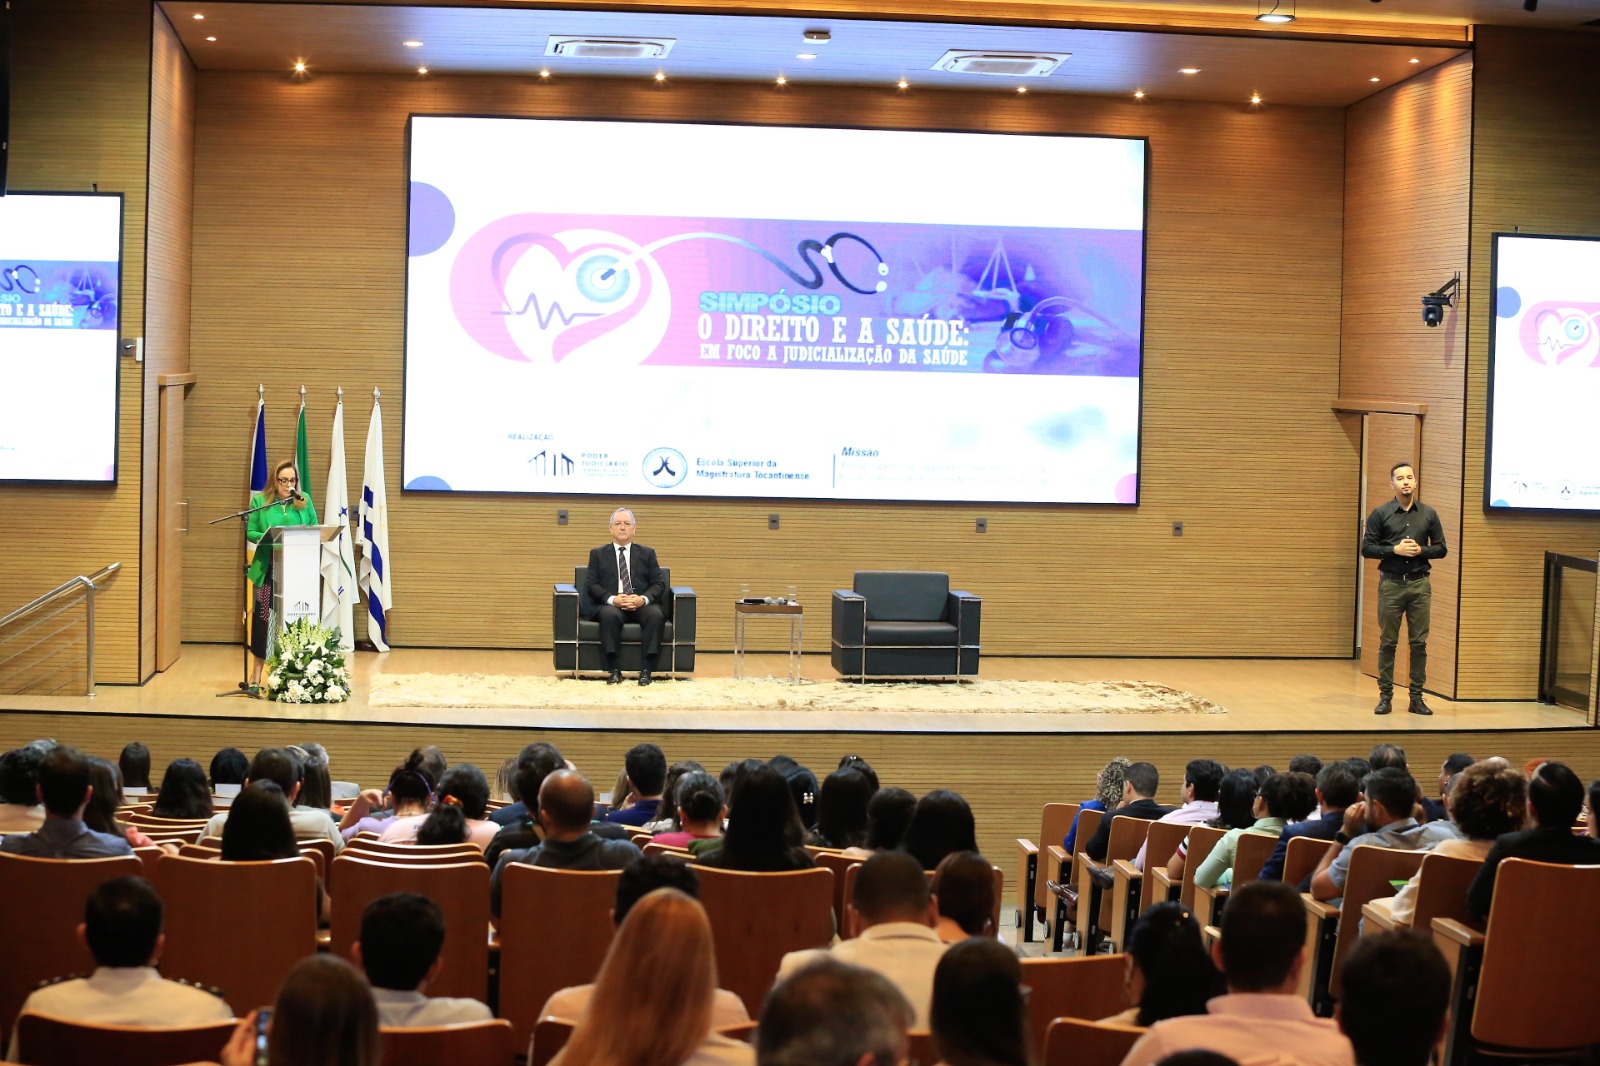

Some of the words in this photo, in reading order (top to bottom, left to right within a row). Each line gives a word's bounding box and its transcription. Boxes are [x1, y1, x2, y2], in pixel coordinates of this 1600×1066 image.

[16, 303, 24, 317] E
[27, 303, 35, 317] A
[698, 288, 842, 315] SIMPÓSIO
[697, 313, 713, 341] O
[725, 314, 820, 343] DIREITO
[832, 316, 847, 344] E
[857, 317, 875, 344] A
[886, 313, 970, 346] SAÚDE:
[699, 344, 721, 360] EM
[726, 344, 760, 361] FOCO
[766, 346, 777, 361] A
[782, 343, 892, 366] JUDICIALIZAÇÃO
[899, 347, 917, 364] DA
[922, 344, 967, 366] SAÚDE
[696, 458, 724, 467] Escola
[727, 458, 764, 468] Superior
[766, 459, 777, 468] da
[696, 470, 751, 480] Magistratura
[755, 471, 810, 480] Tocantinense
